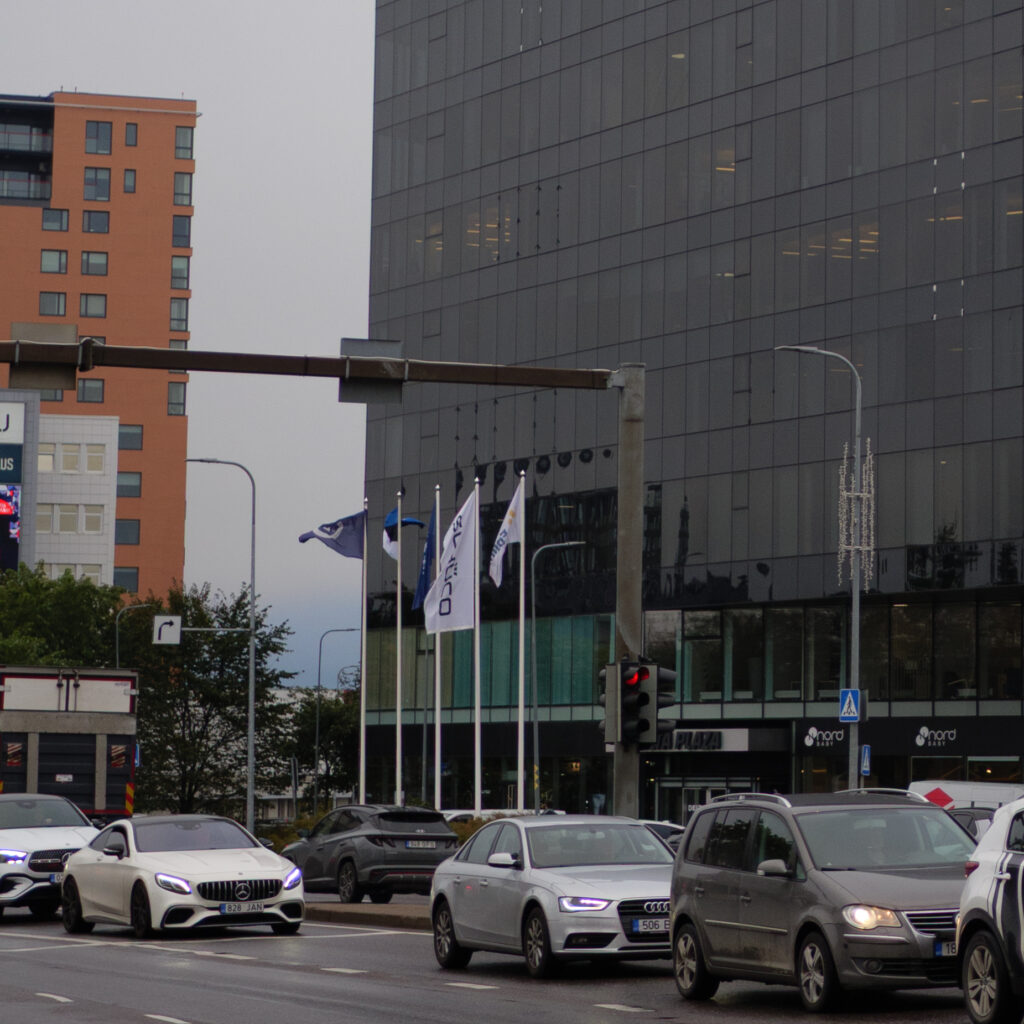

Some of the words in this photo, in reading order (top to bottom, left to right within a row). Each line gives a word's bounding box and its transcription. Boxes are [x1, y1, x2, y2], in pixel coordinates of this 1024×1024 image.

[675, 731, 722, 750] PLAZA
[817, 729, 844, 741] nord
[928, 729, 956, 741] nord
[642, 920, 660, 930] 506
